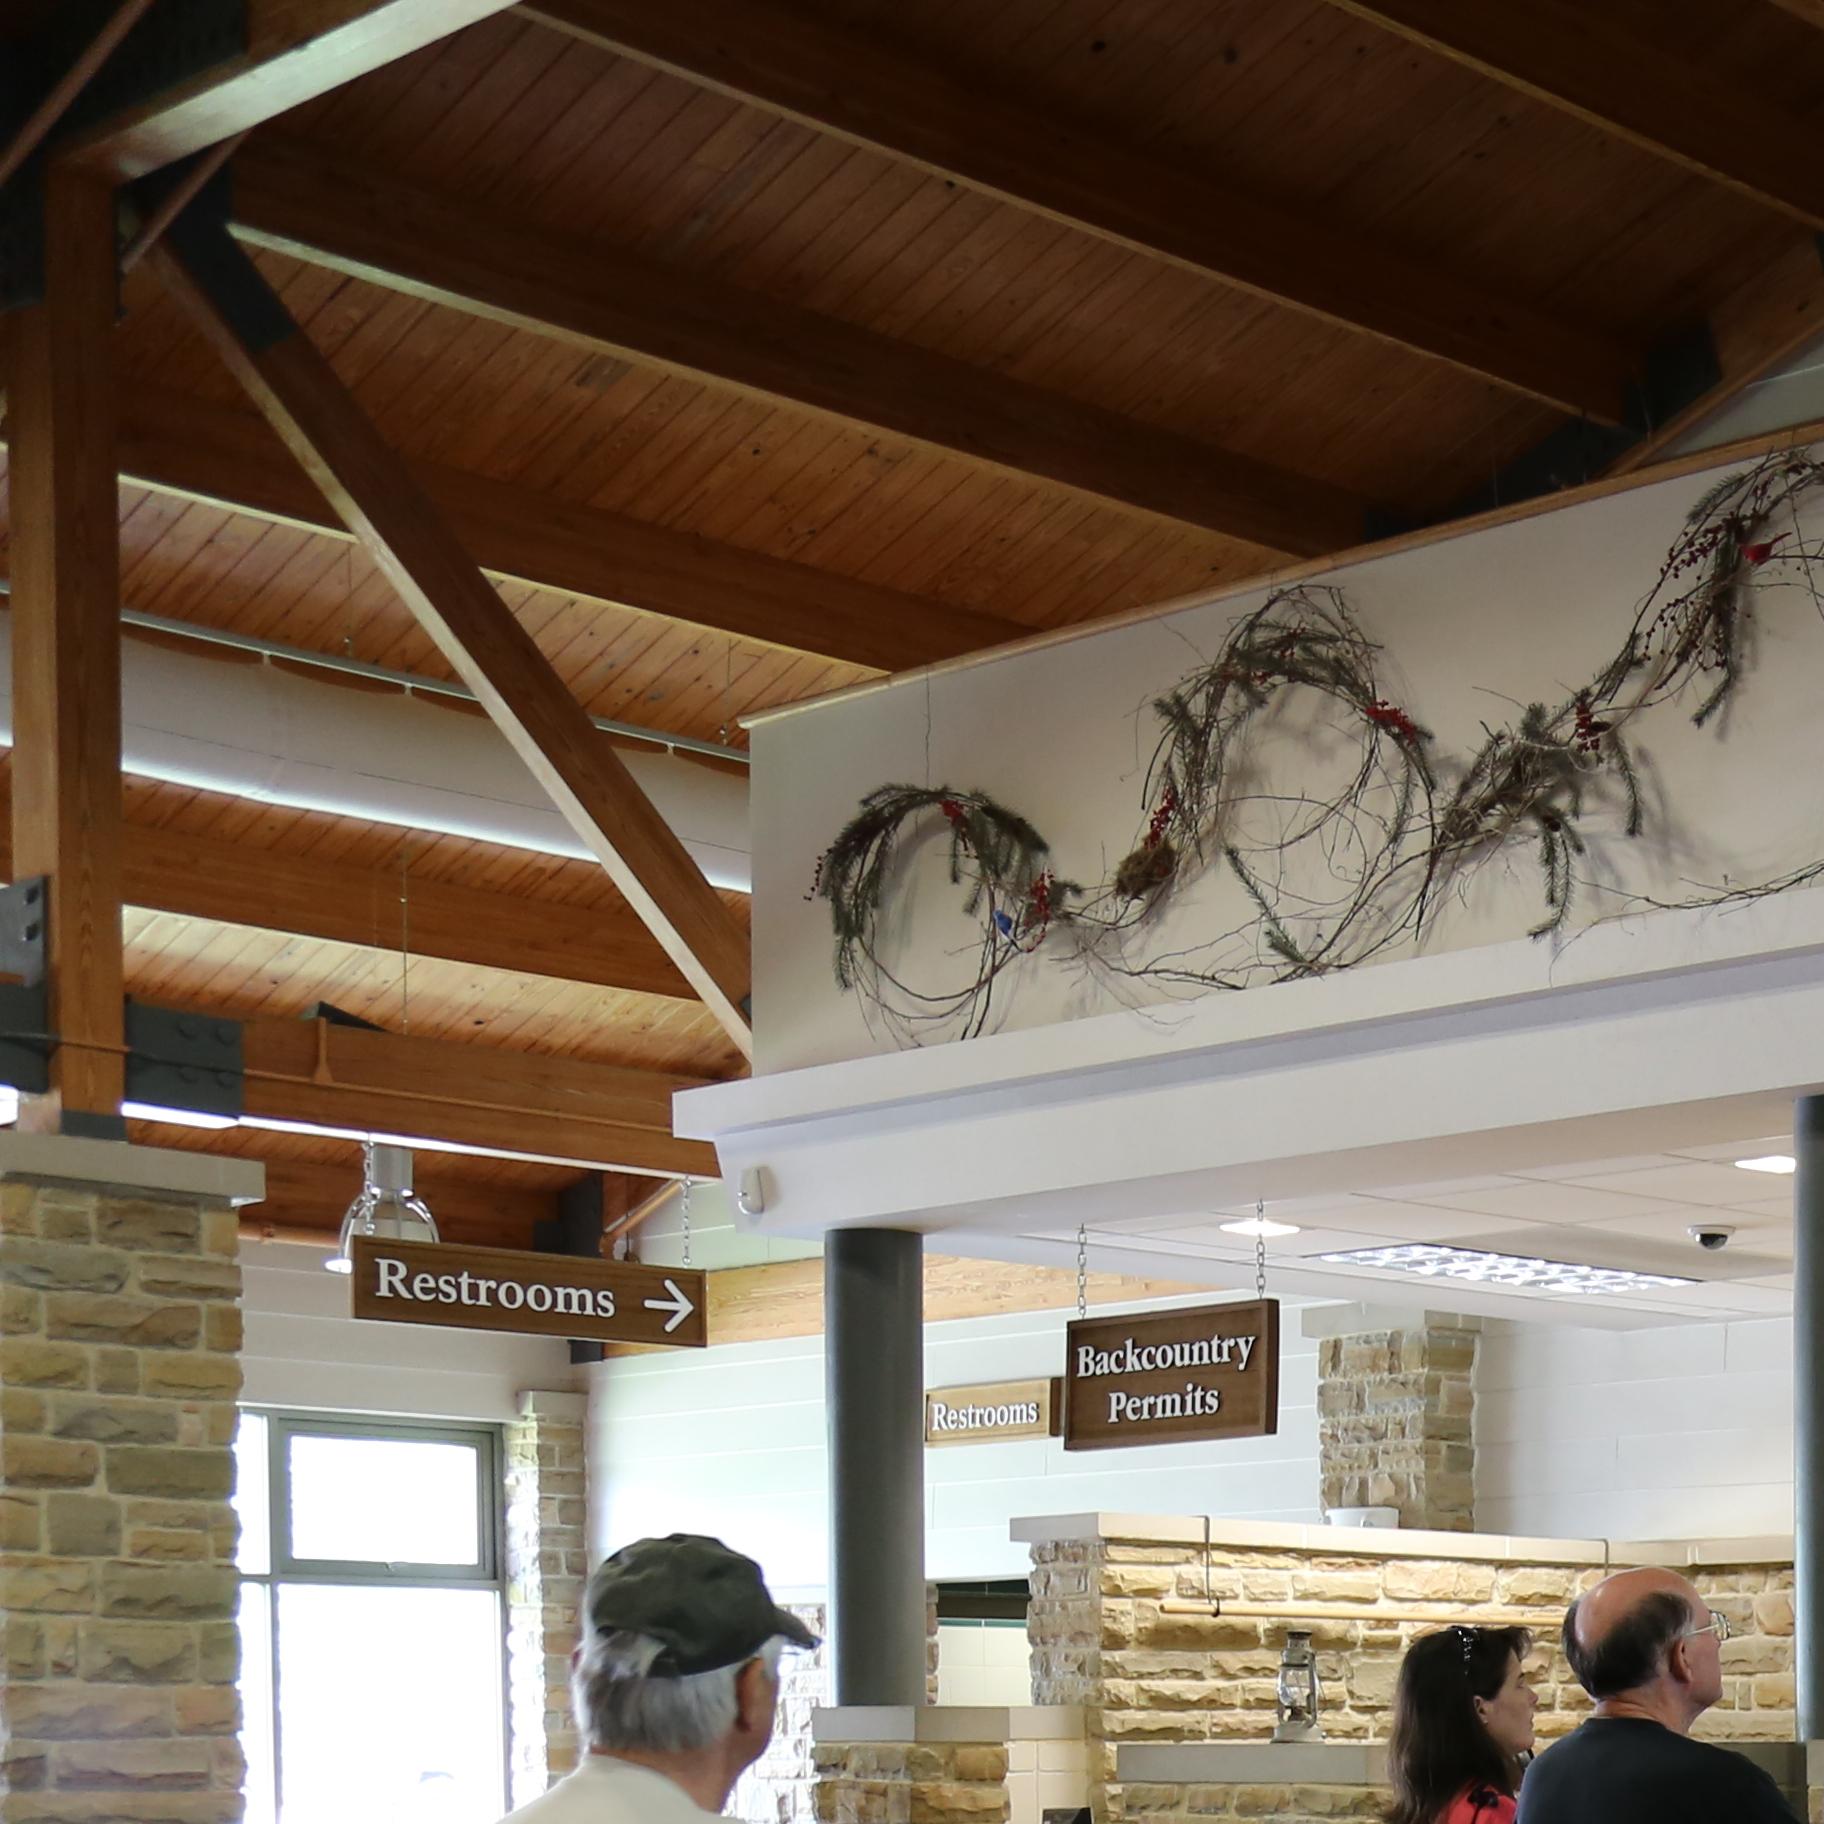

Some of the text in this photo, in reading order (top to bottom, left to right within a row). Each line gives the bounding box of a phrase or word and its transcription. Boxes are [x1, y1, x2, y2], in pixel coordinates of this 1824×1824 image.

[374, 1257, 617, 1318] Restrooms
[1076, 1333, 1257, 1379] Backcountry
[931, 1401, 1039, 1432] Restrooms
[1107, 1382, 1220, 1425] Permits
